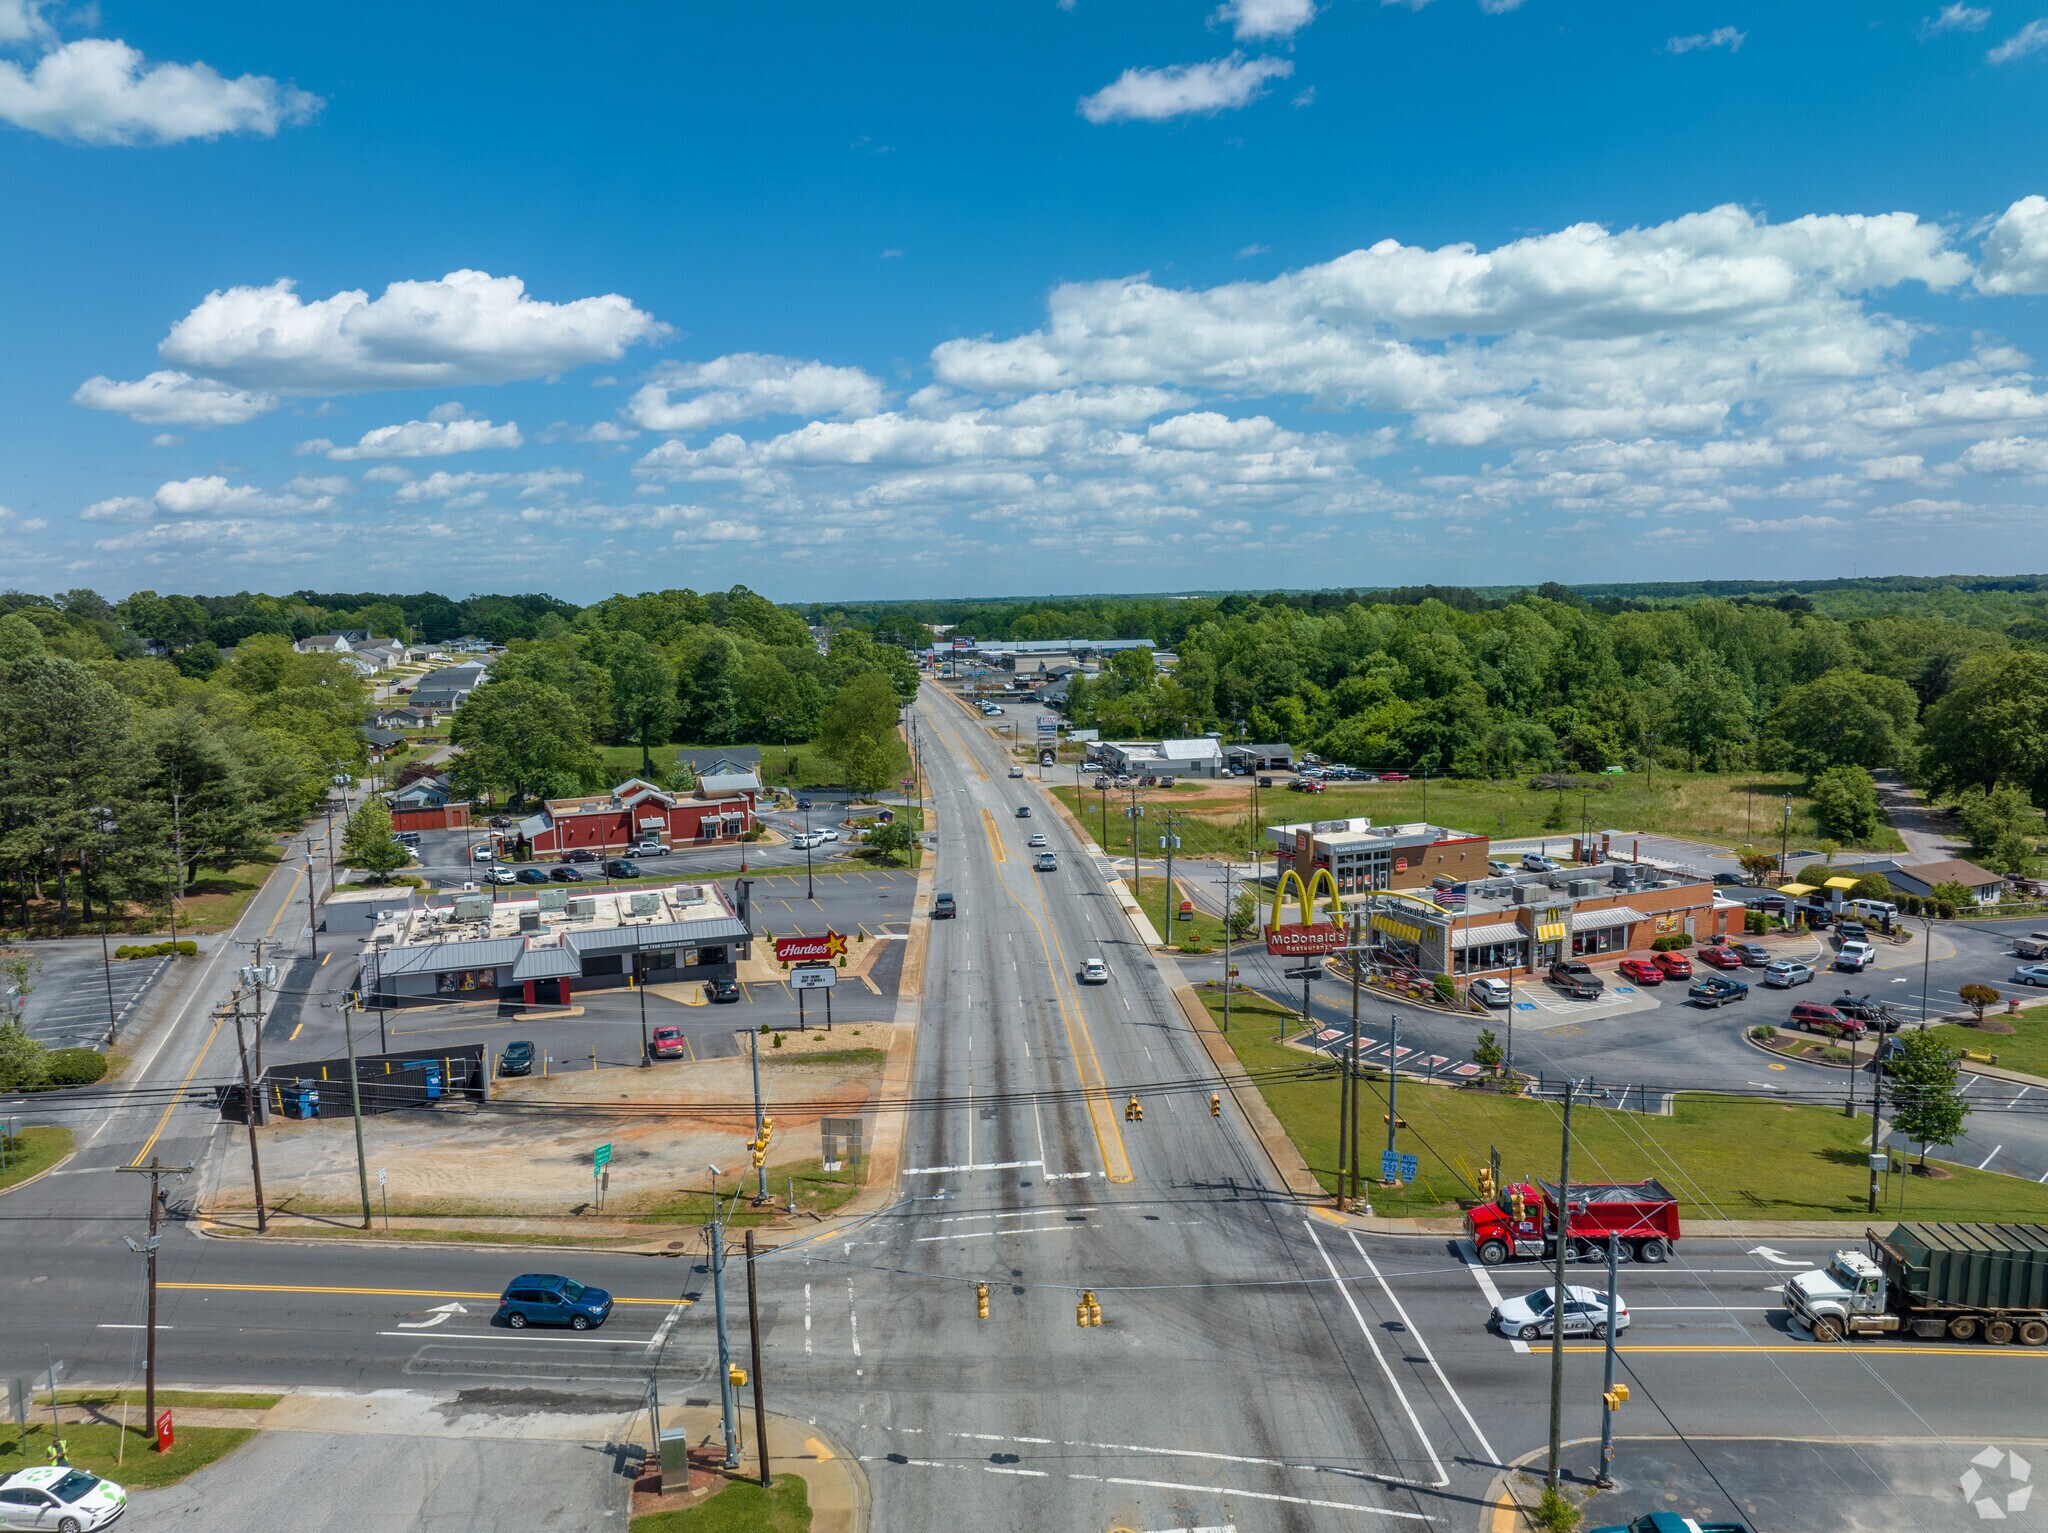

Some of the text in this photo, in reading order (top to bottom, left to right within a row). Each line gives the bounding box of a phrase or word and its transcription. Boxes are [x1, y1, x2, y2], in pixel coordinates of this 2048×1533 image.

[1271, 933, 1345, 944] McDonald's
[1382, 1163, 1397, 1172] 292
[1401, 1166, 1416, 1175] 292
